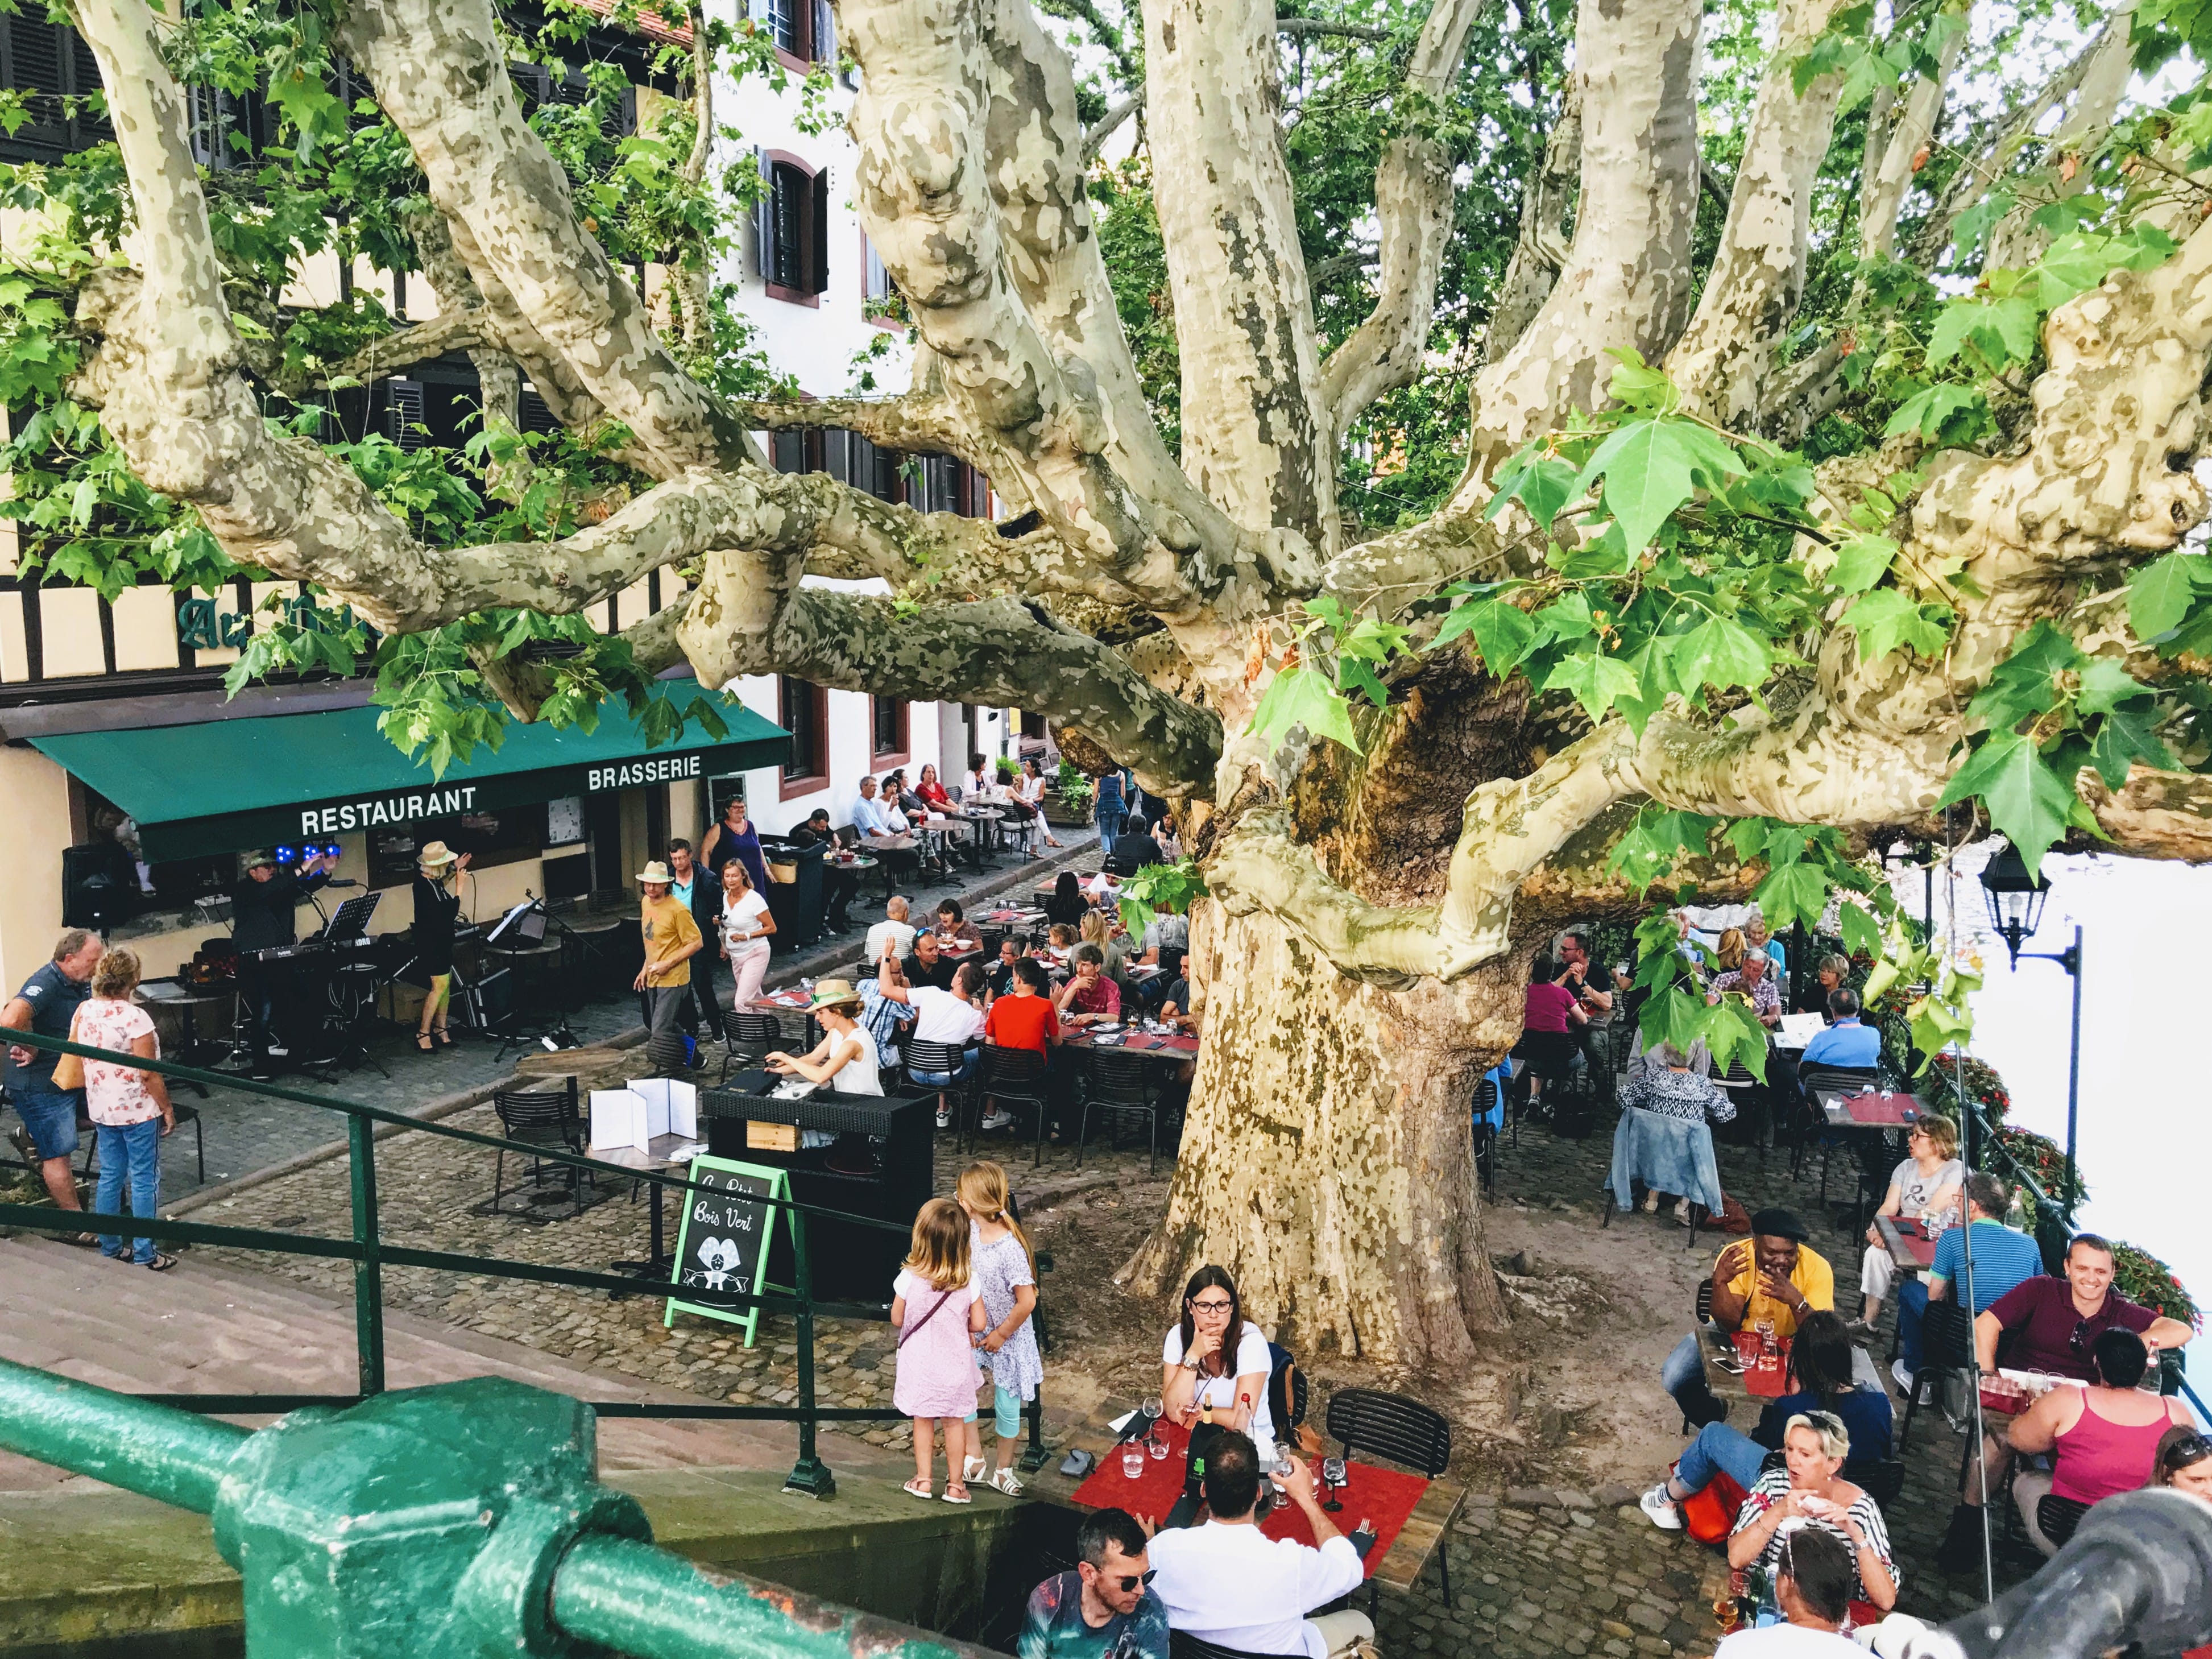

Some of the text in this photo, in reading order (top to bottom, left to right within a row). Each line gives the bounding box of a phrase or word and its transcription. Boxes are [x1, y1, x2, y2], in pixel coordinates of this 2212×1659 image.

[179, 598, 248, 649] Au
[589, 755, 701, 791] BRASSERIE
[301, 787, 476, 835] RESTAURANT
[694, 1201, 753, 1232] Bois Vert
